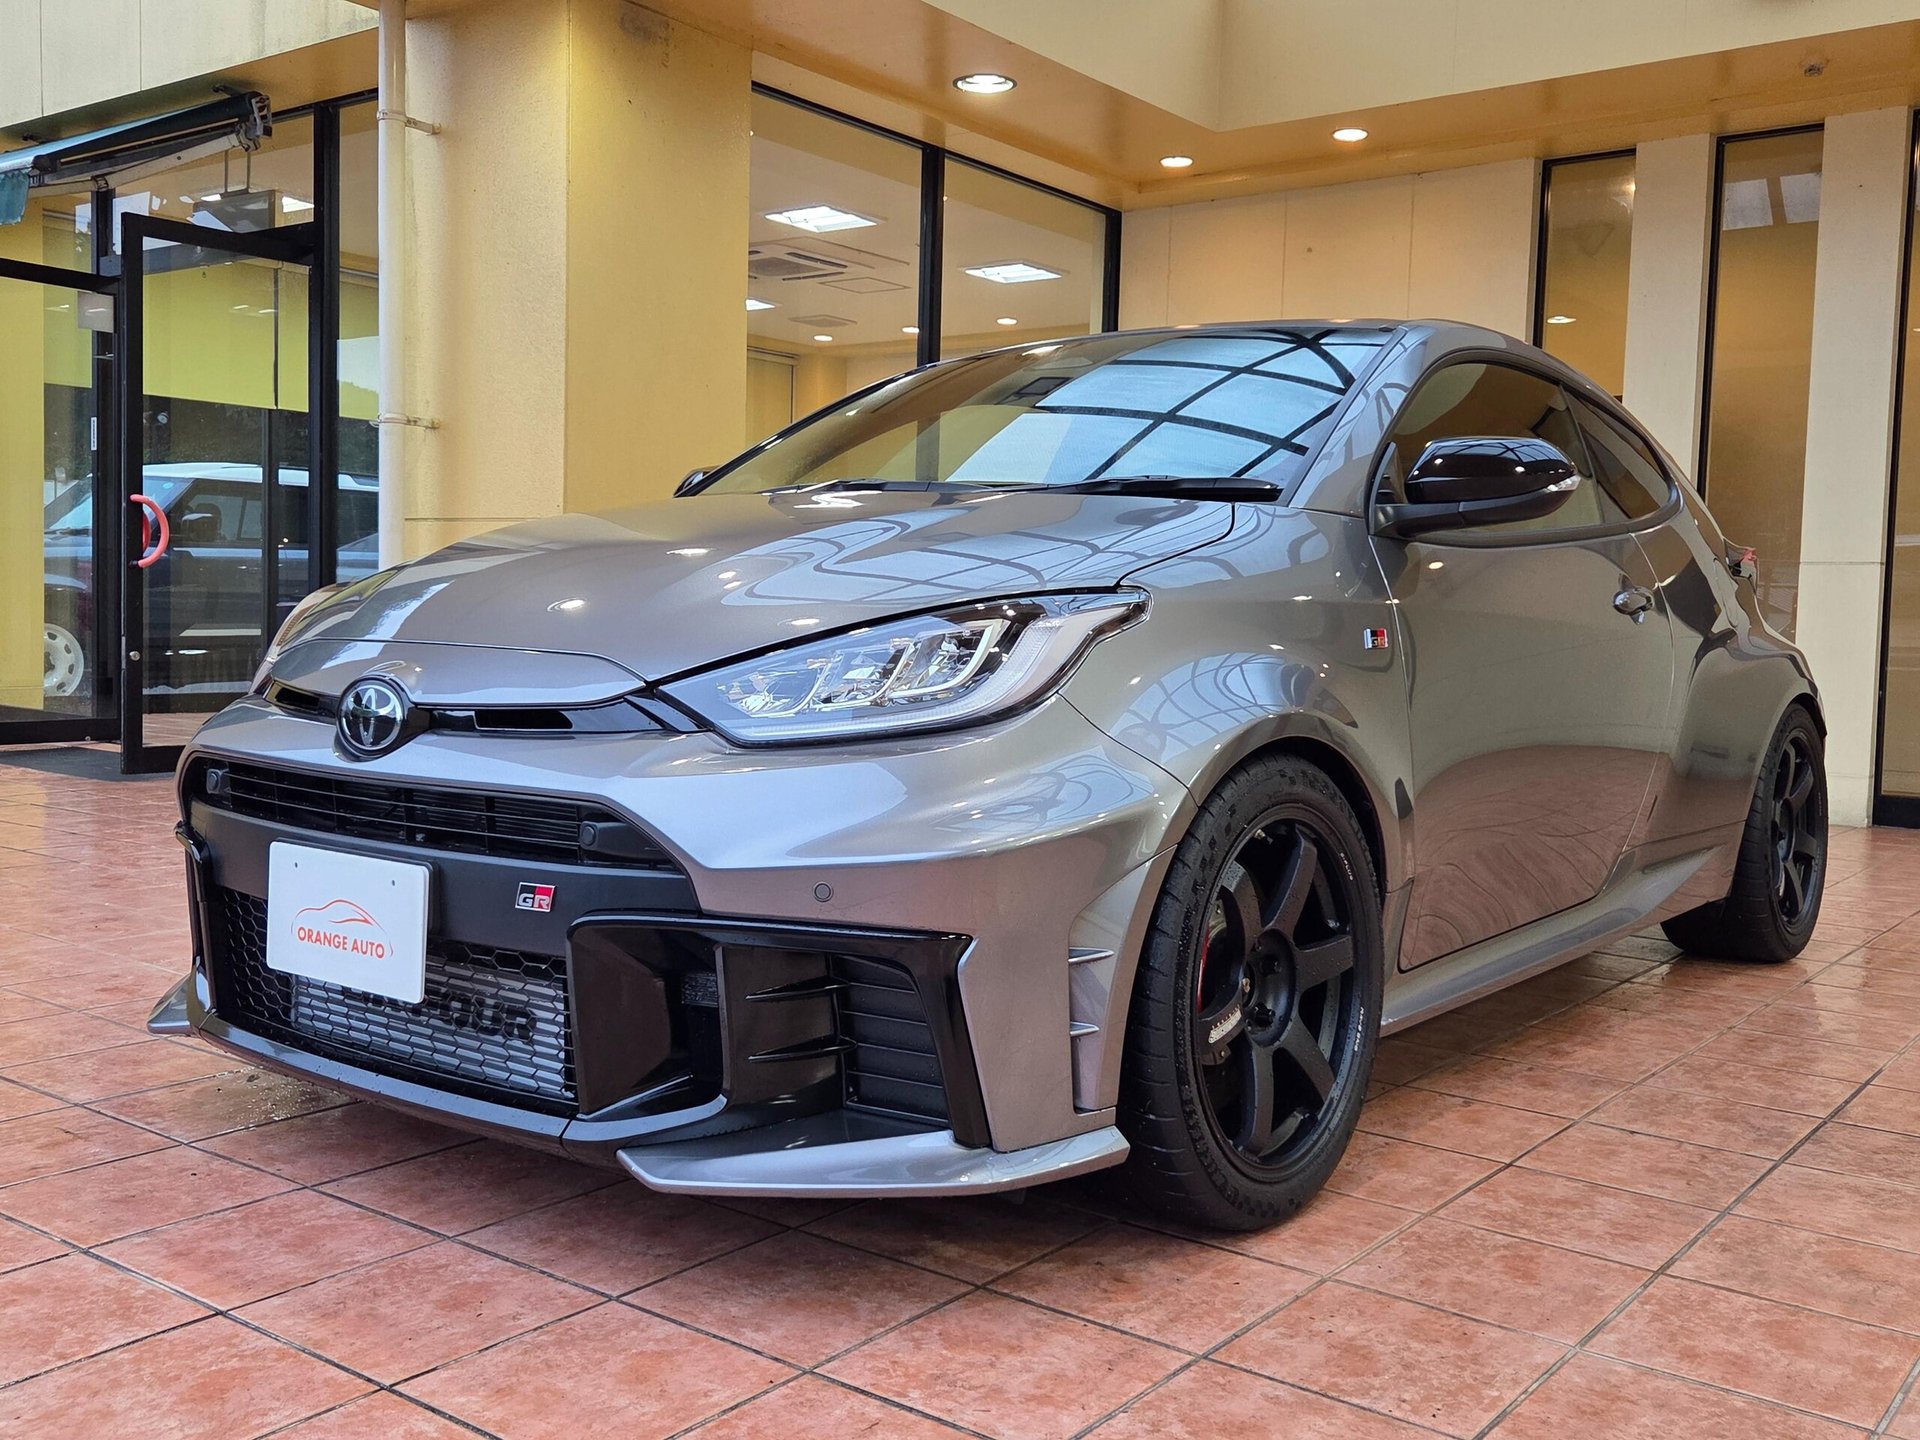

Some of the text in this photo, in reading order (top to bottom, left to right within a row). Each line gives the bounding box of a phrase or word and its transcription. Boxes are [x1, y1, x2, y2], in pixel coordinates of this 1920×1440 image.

[518, 892, 551, 909] GR
[297, 926, 385, 959] ORANGE AUTO
